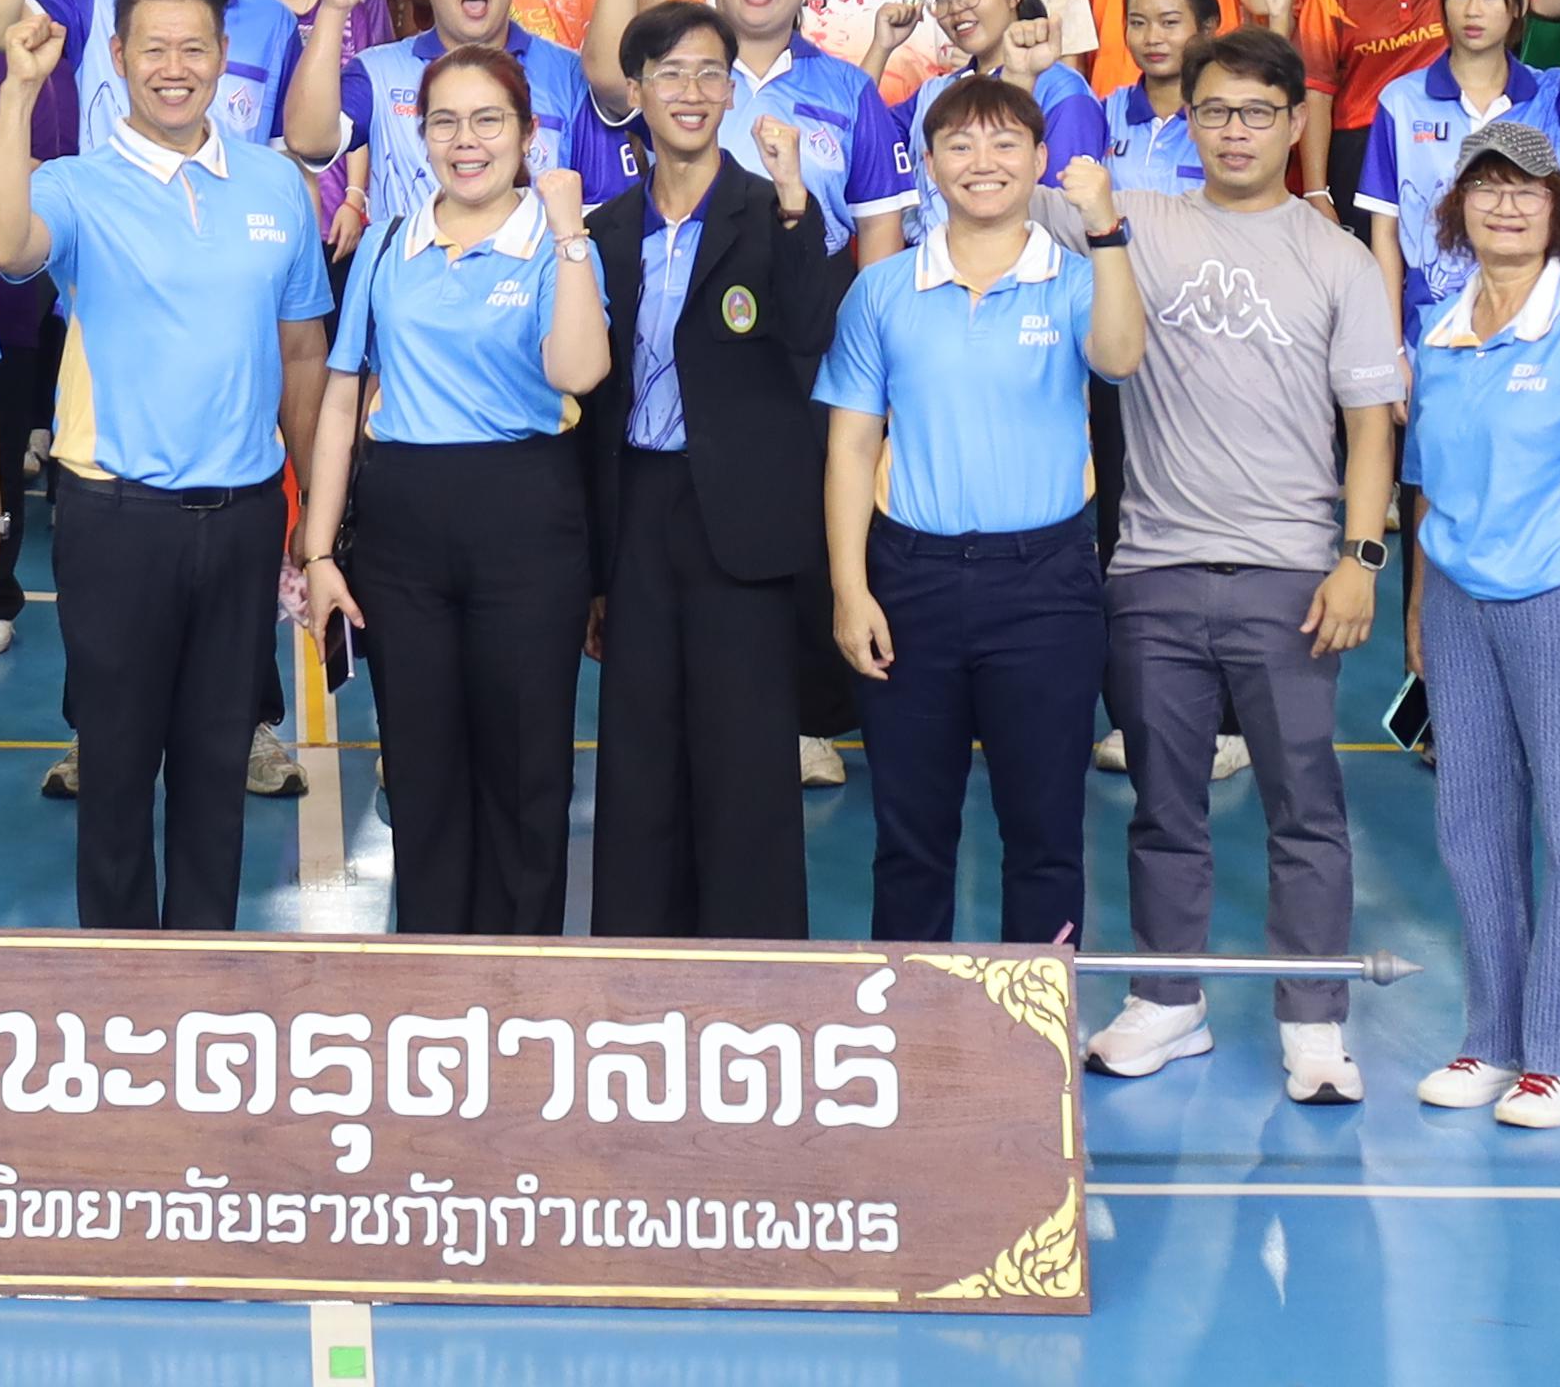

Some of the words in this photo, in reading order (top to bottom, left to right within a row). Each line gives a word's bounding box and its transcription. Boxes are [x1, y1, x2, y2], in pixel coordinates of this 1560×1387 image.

[247, 213, 276, 228] EDU
[249, 228, 287, 244] KPRU
[486, 292, 531, 308] KPRU
[1018, 330, 1061, 346] KPRU
